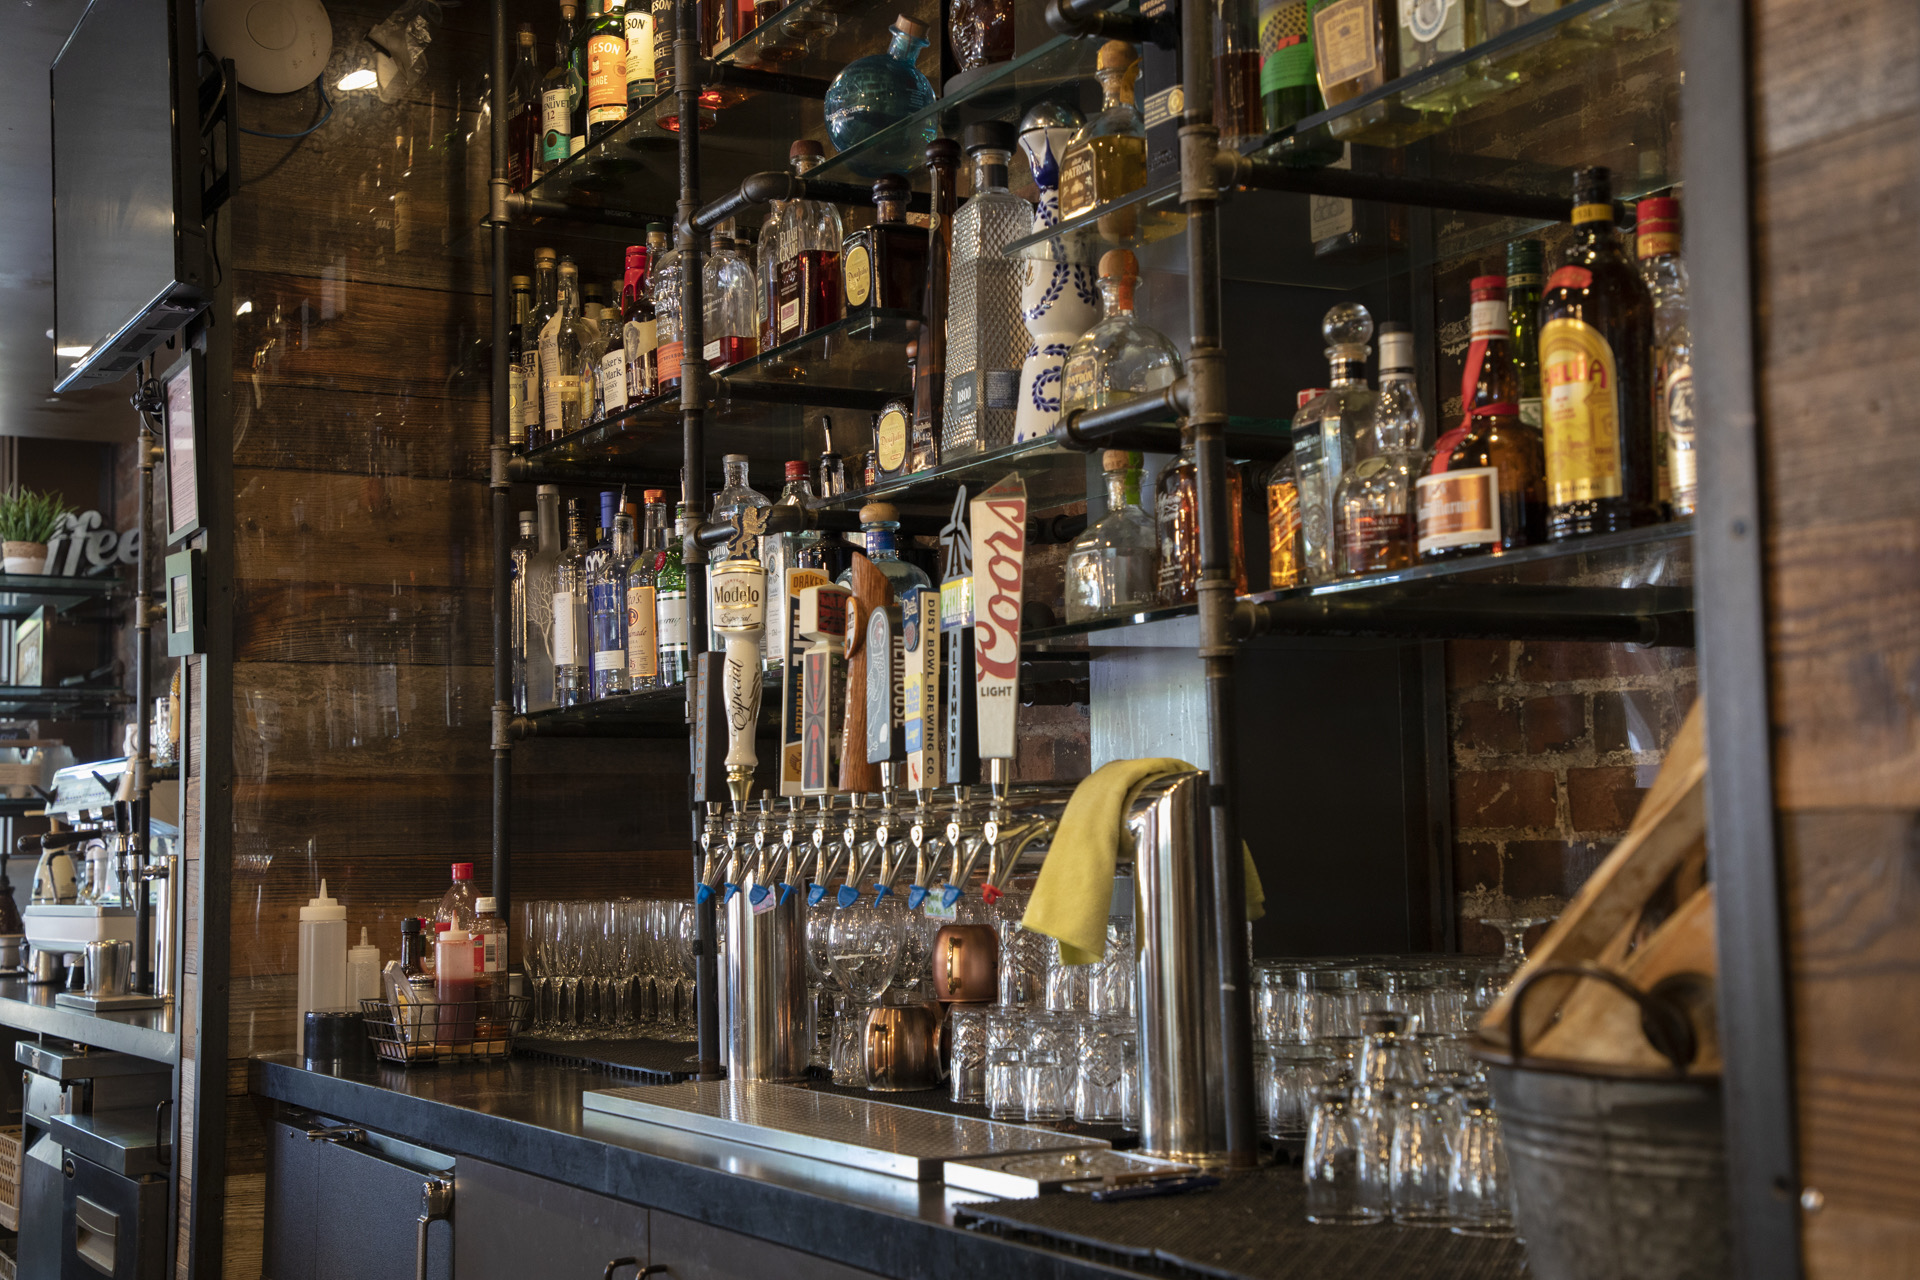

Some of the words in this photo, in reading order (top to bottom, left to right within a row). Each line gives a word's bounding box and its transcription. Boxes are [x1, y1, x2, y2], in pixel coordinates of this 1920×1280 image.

[547, 110, 556, 120] 12
[602, 355, 623, 371] aker's
[42, 510, 140, 576] ffee
[714, 586, 759, 604] Modelo
[975, 500, 1025, 683] Coors
[927, 599, 935, 634] DUST
[927, 640, 935, 679] BOWL
[731, 658, 751, 737] Especial
[980, 686, 1013, 698] LIGHT
[695, 658, 706, 794] FIELDWORK
[926, 684, 935, 751] BREWING
[926, 757, 935, 779] CO.
